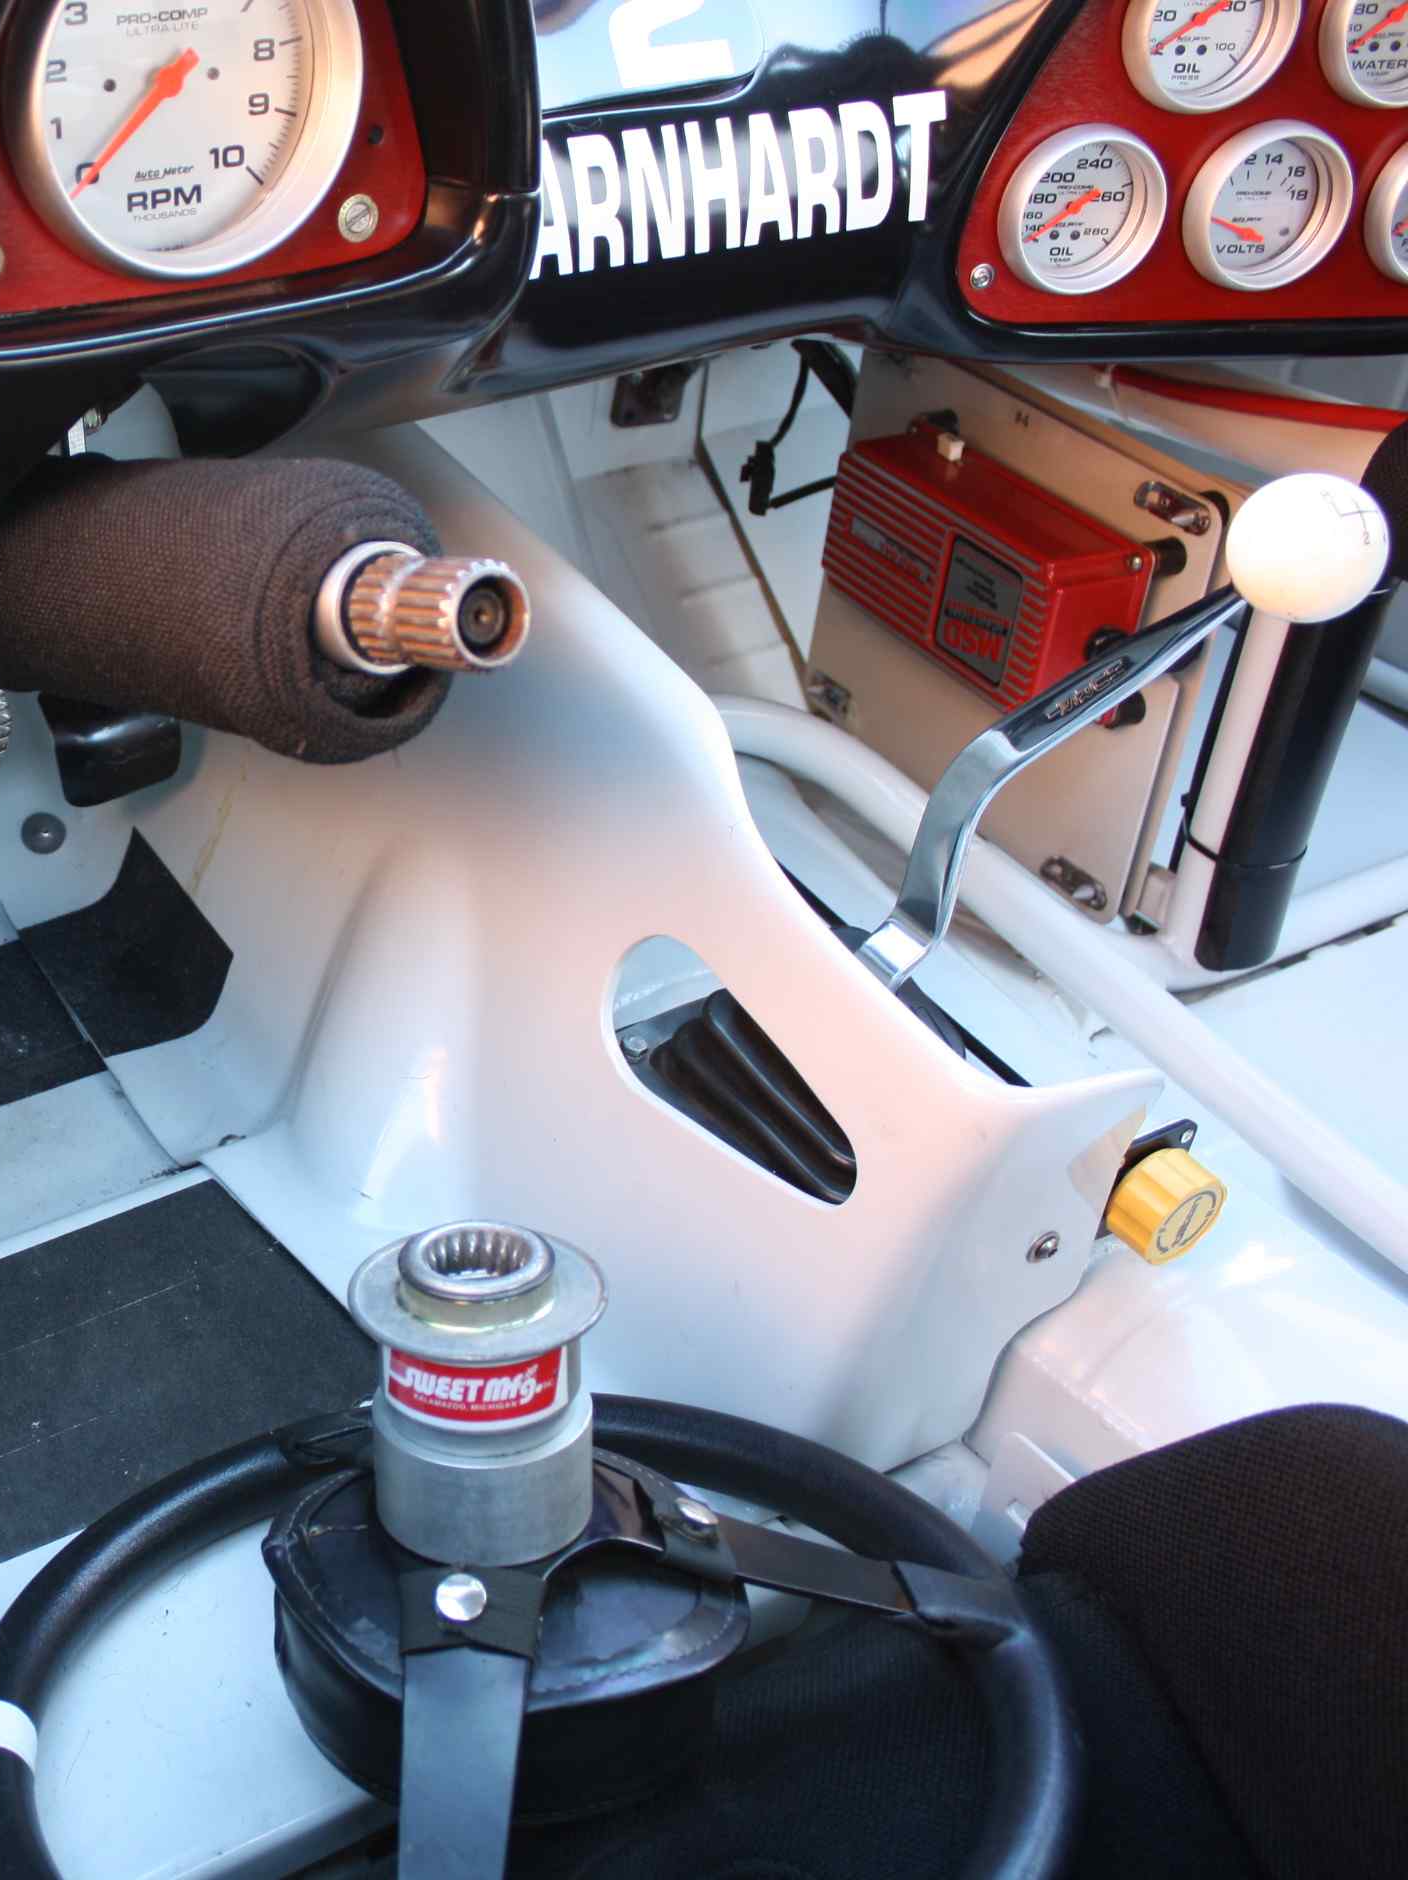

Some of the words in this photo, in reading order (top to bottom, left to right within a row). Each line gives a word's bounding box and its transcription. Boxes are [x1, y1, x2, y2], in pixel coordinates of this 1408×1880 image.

[64, 1, 89, 26] 3
[115, 7, 209, 26] PRO-COMP
[253, 38, 276, 61] 8
[1215, 42, 1237, 51] 100
[45, 59, 68, 83] 2
[1173, 63, 1201, 74] OIL
[247, 93, 270, 116] 9
[50, 117, 63, 140] 1
[209, 145, 245, 169] 10
[1076, 158, 1113, 169] 240
[1265, 153, 1284, 165] 14
[134, 168, 160, 181] Auto
[161, 165, 195, 180] Meter
[1039, 172, 1076, 183] 200
[1288, 166, 1307, 177] 16
[528, 90, 947, 281] ARNHARDT
[127, 184, 202, 212] RPM
[1290, 189, 1309, 200] 18
[132, 207, 198, 222] THOUSANDS
[1083, 228, 1110, 236] 280
[1049, 247, 1074, 257] OIL
[1215, 244, 1265, 254] VOLTS
[398, 1365, 484, 1404] SWEET
